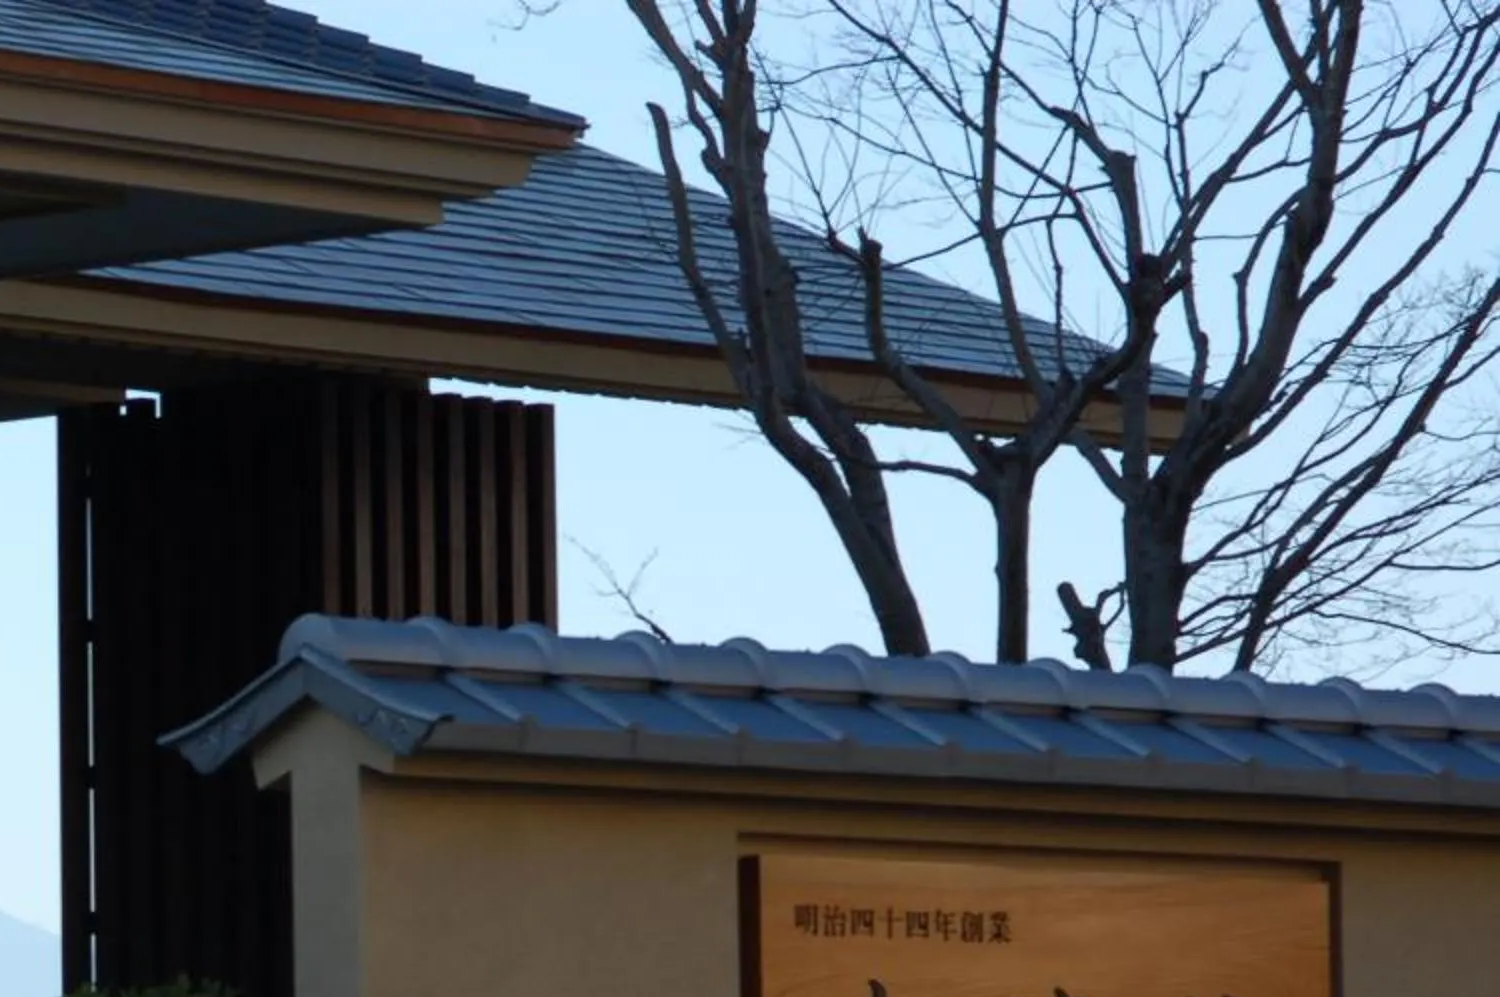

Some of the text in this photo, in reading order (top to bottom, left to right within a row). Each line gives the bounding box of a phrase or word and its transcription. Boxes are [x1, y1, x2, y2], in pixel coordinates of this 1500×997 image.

[794, 904, 1012, 943] 明治四十四年創業
